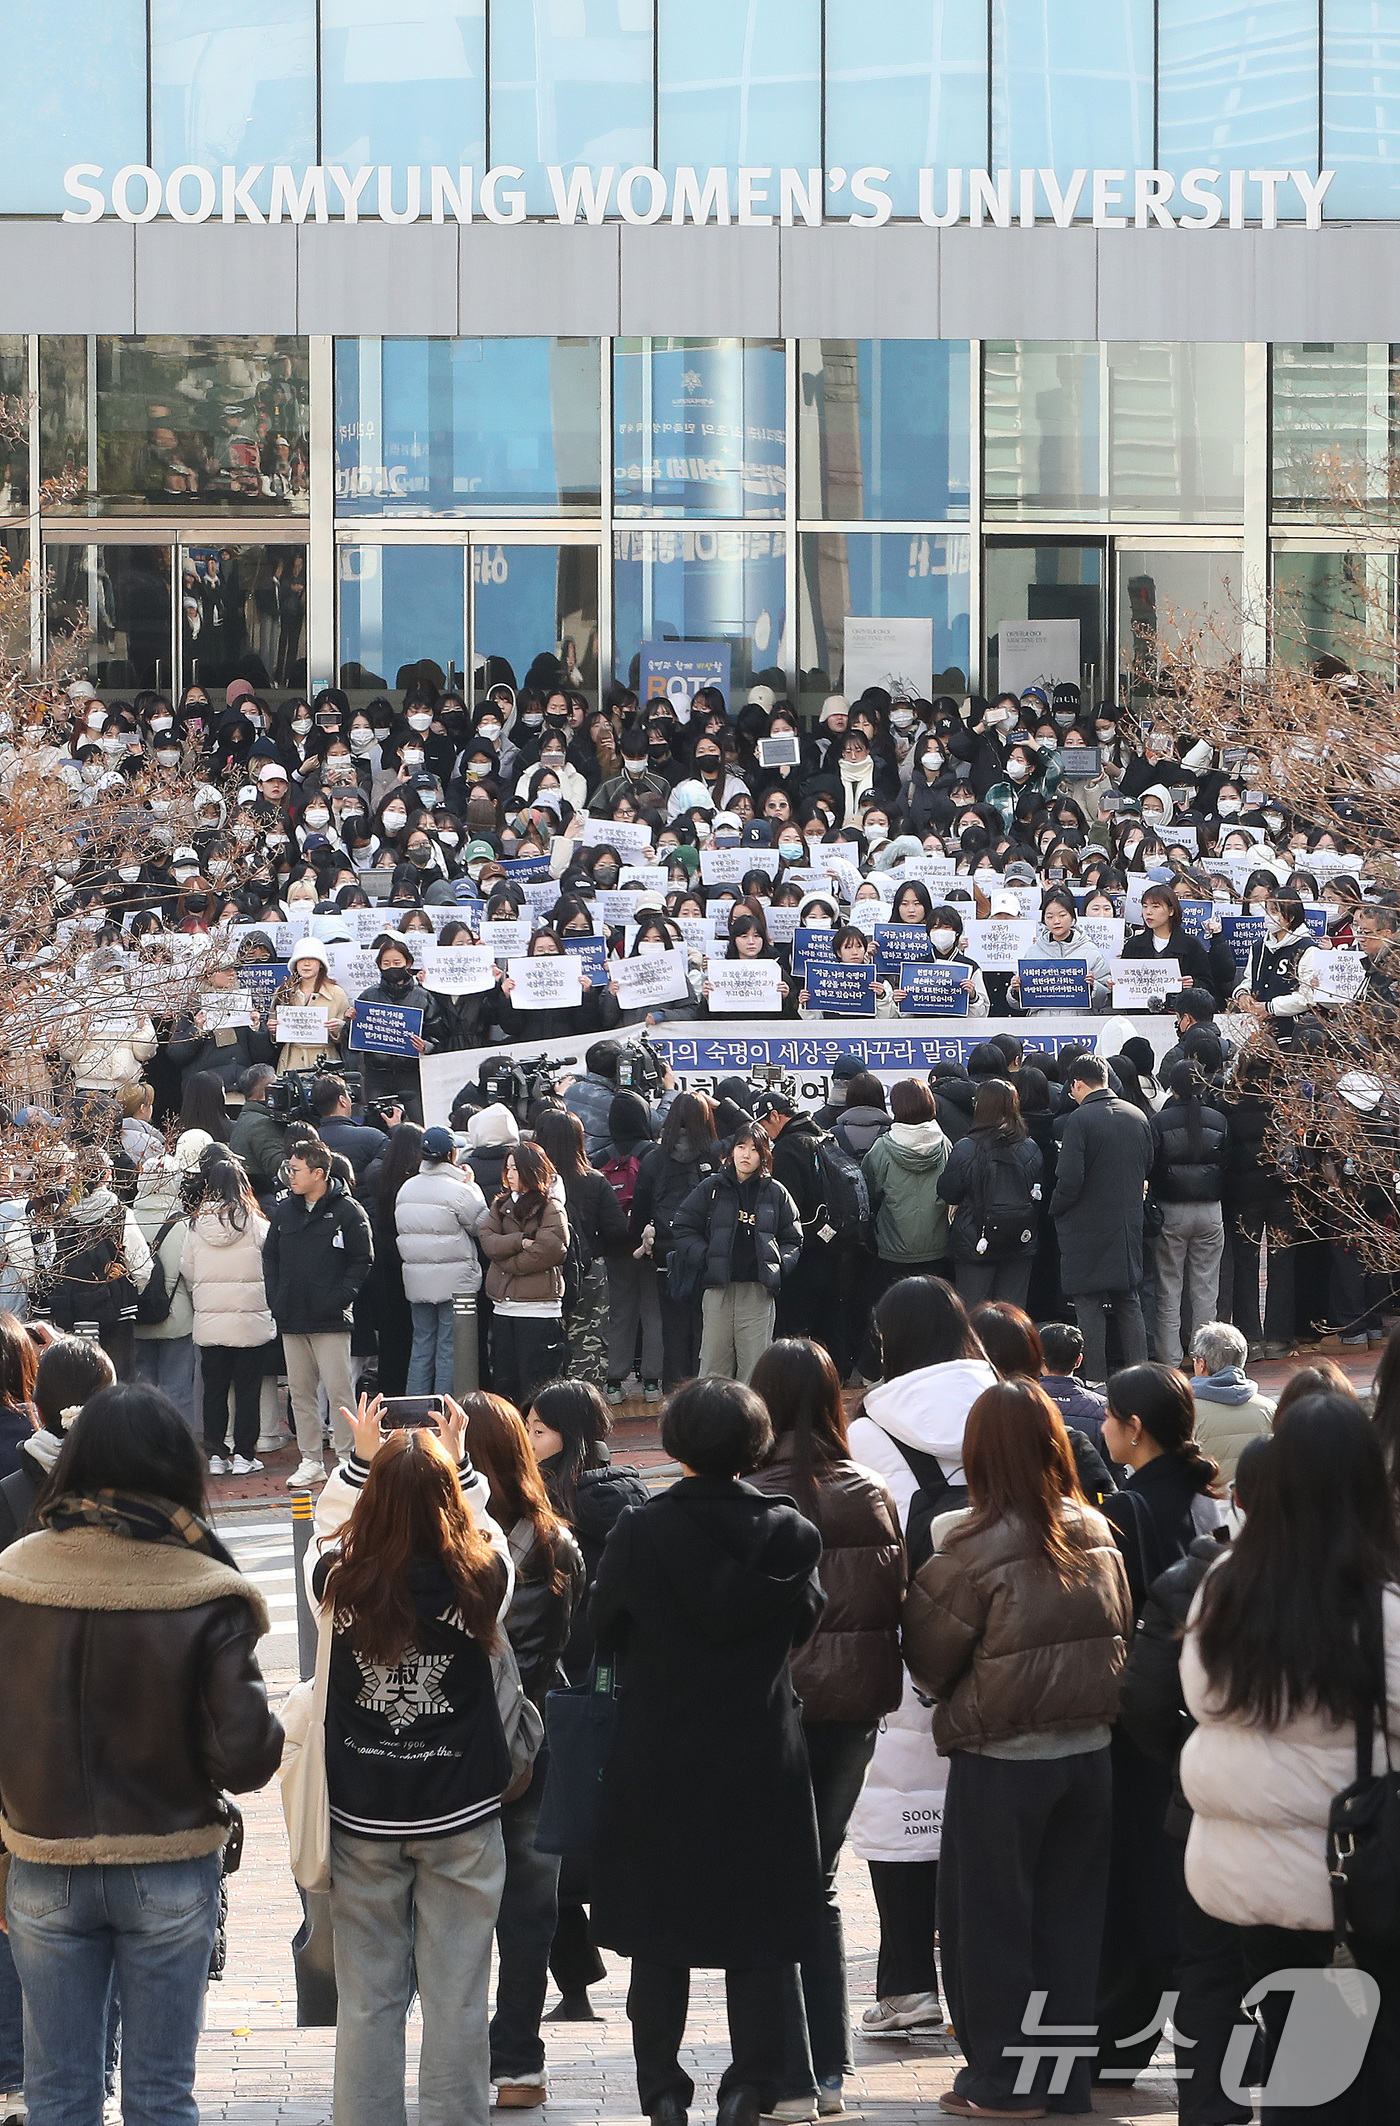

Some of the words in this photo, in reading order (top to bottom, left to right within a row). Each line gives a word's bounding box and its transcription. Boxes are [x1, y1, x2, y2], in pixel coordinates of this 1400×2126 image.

[62, 163, 527, 225] SOOKMYUNG
[547, 165, 893, 228] WOMEN'S
[918, 167, 1337, 230] UNIVERSITY
[750, 828, 761, 841] S
[1276, 958, 1289, 976] S
[831, 970, 845, 979] 나의
[846, 971, 867, 981] 숙명이
[819, 979, 839, 988] 세상을
[840, 981, 861, 990] 바꾸라
[814, 988, 835, 997] 말하고
[704, 1040, 772, 1066] 숙명이
[777, 1040, 845, 1066] 세상을
[848, 1039, 917, 1066] 바꾸라
[436, 1745, 454, 1758] the
[901, 1809, 945, 1823] SOOK
